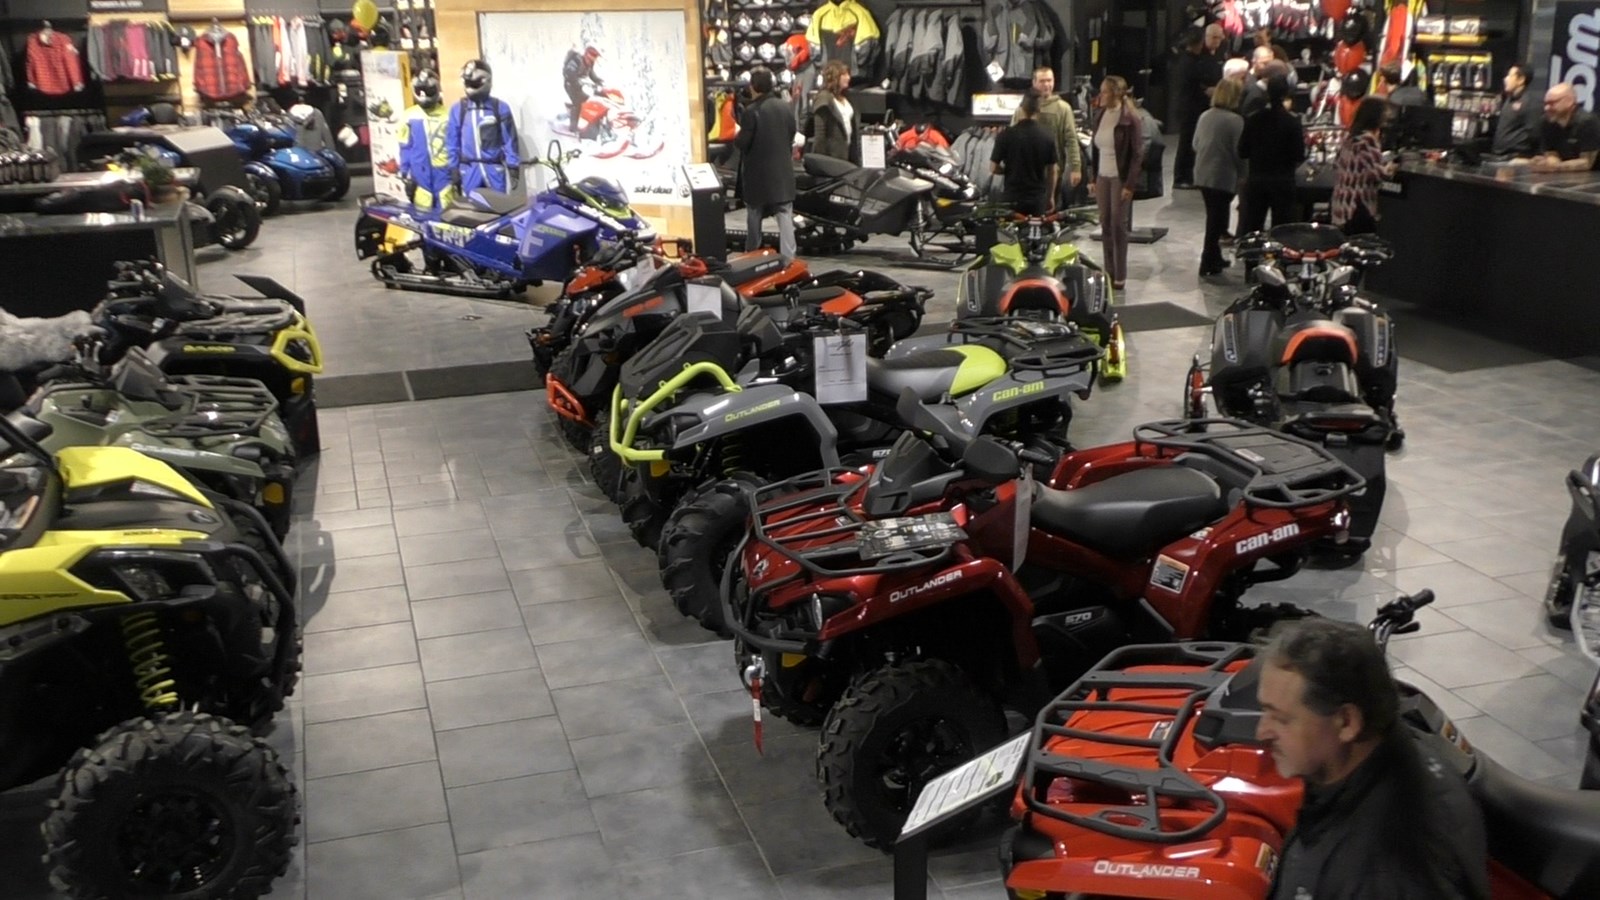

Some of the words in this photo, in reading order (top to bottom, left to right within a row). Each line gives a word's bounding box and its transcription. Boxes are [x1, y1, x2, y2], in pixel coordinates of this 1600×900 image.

[992, 381, 1044, 402] can-am
[724, 399, 781, 422] OUTLANDER
[1235, 523, 1300, 555] can-am
[889, 569, 963, 603] OUTLANDER
[1093, 860, 1201, 878] OUTLANDER
